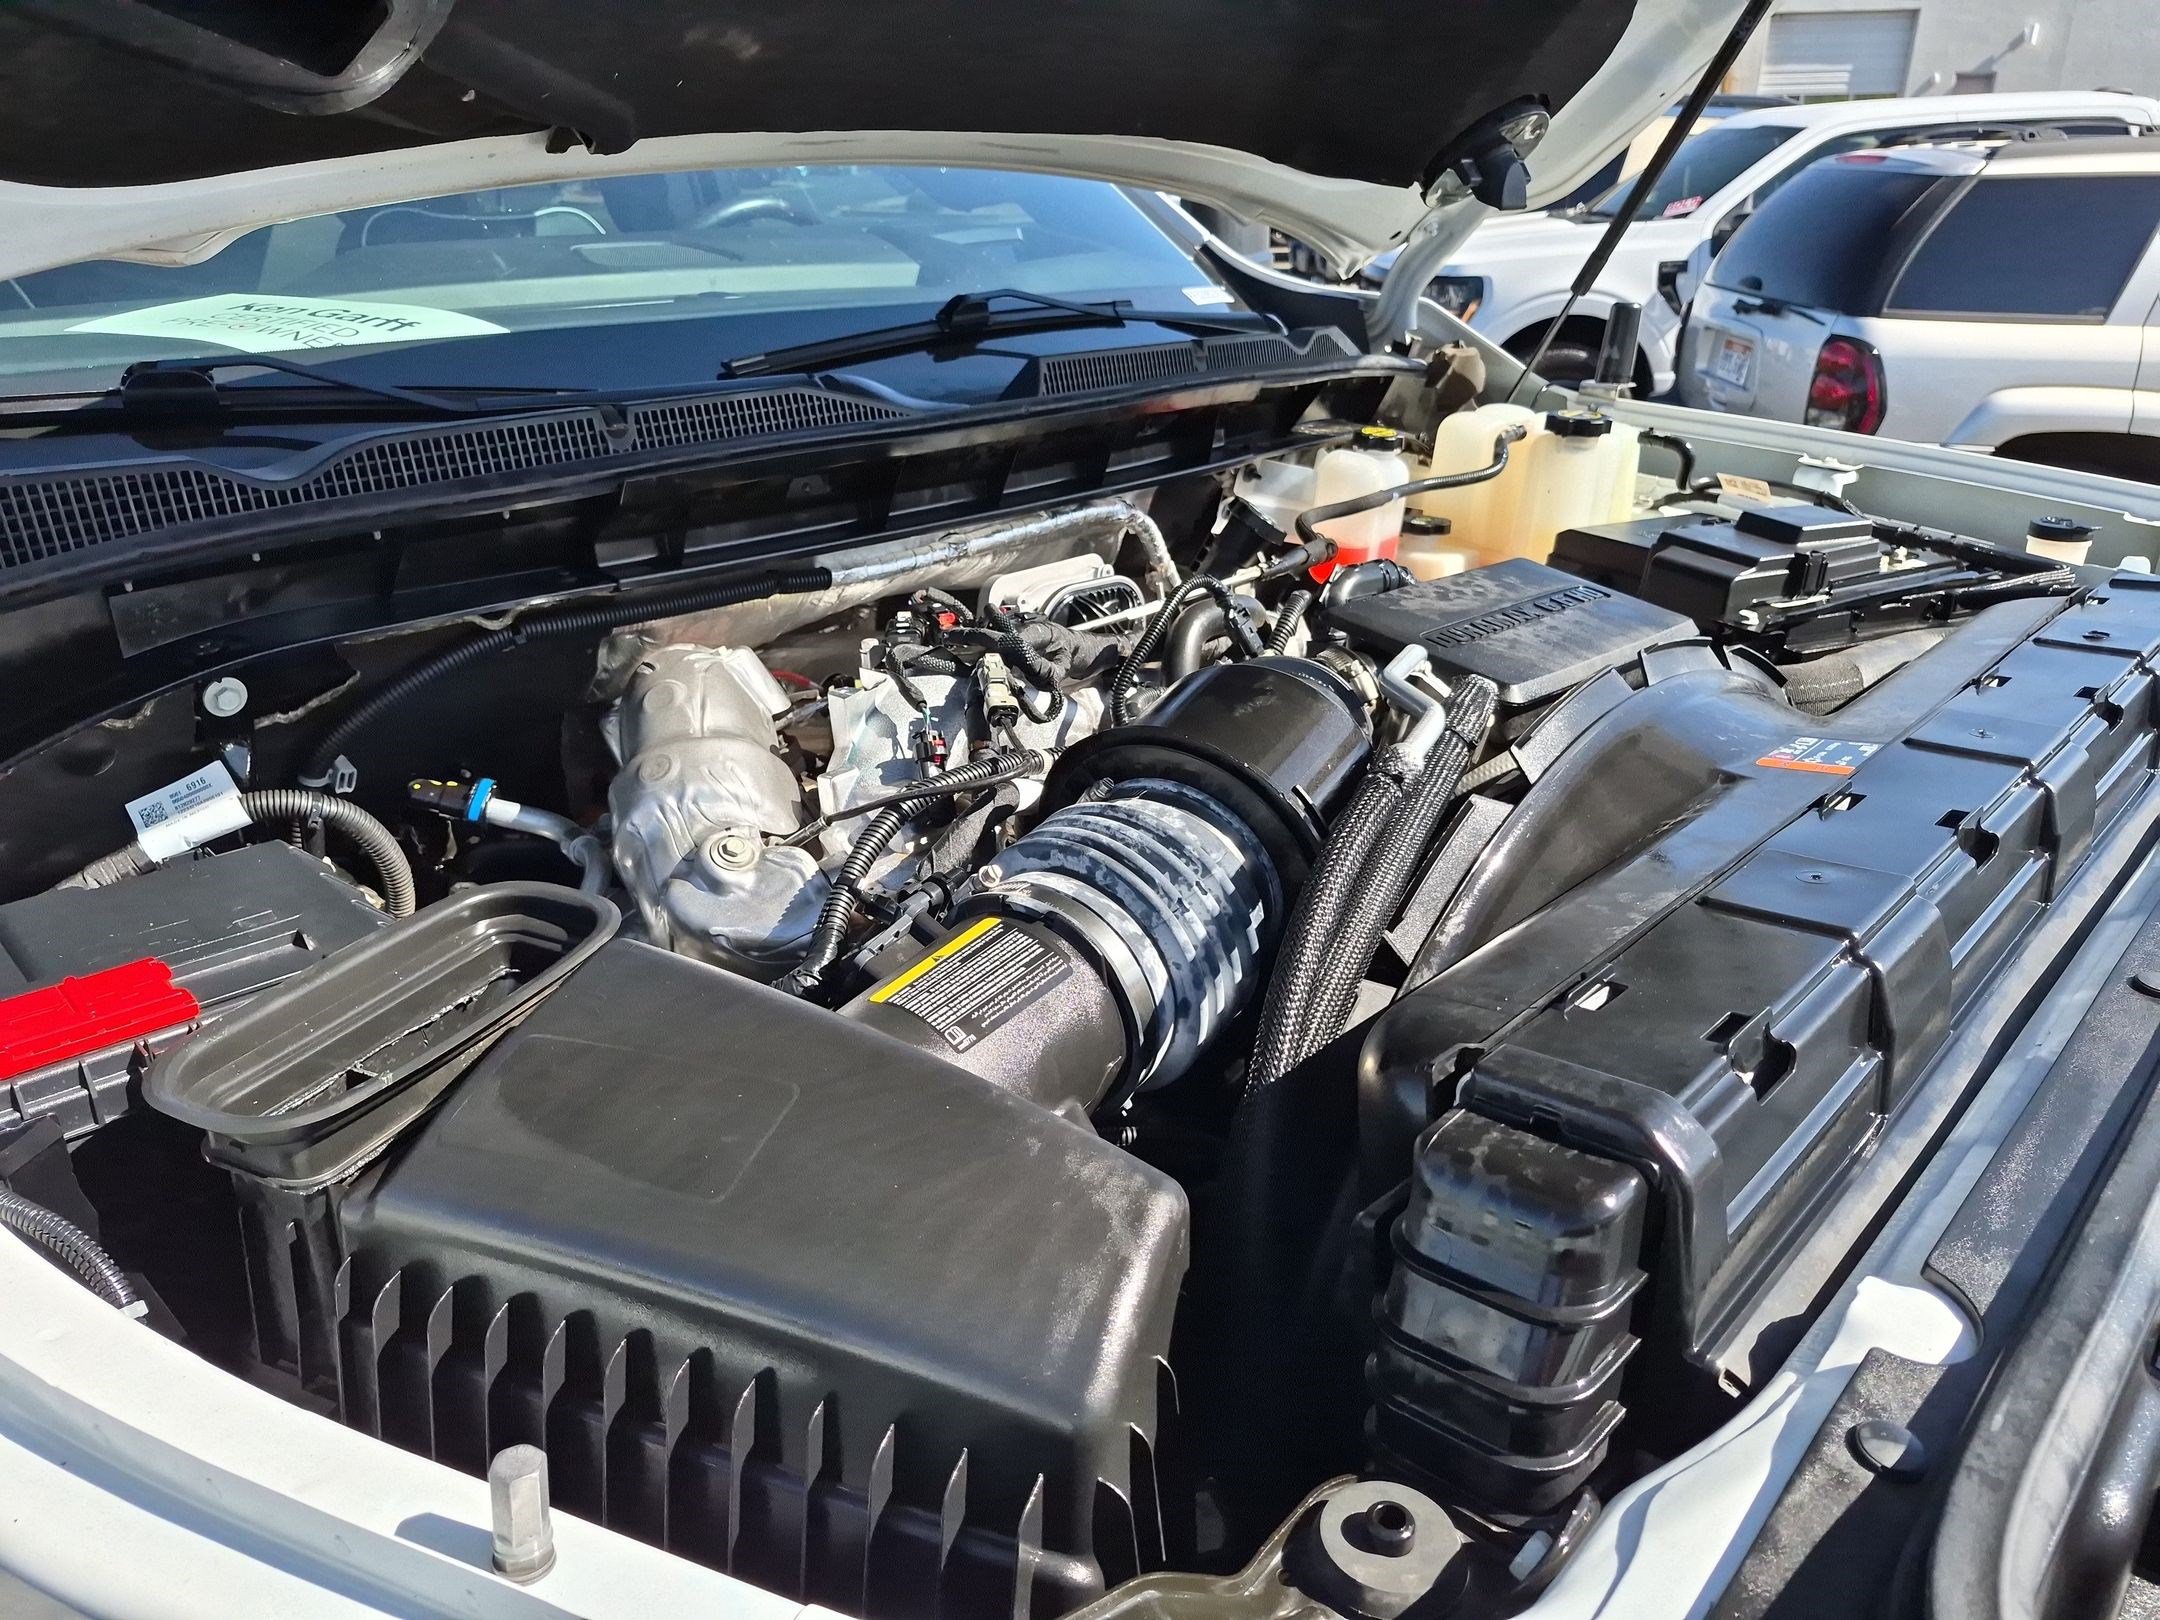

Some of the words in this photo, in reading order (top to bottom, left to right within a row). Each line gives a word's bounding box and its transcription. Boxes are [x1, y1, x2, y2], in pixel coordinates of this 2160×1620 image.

[210, 313, 359, 337] CERTIFIED
[226, 302, 308, 315] Ken
[307, 308, 422, 332] Garff
[160, 317, 345, 349] PRE-OWNE
[1426, 606, 1545, 649] DURAMAX
[186, 776, 206, 791] 6916
